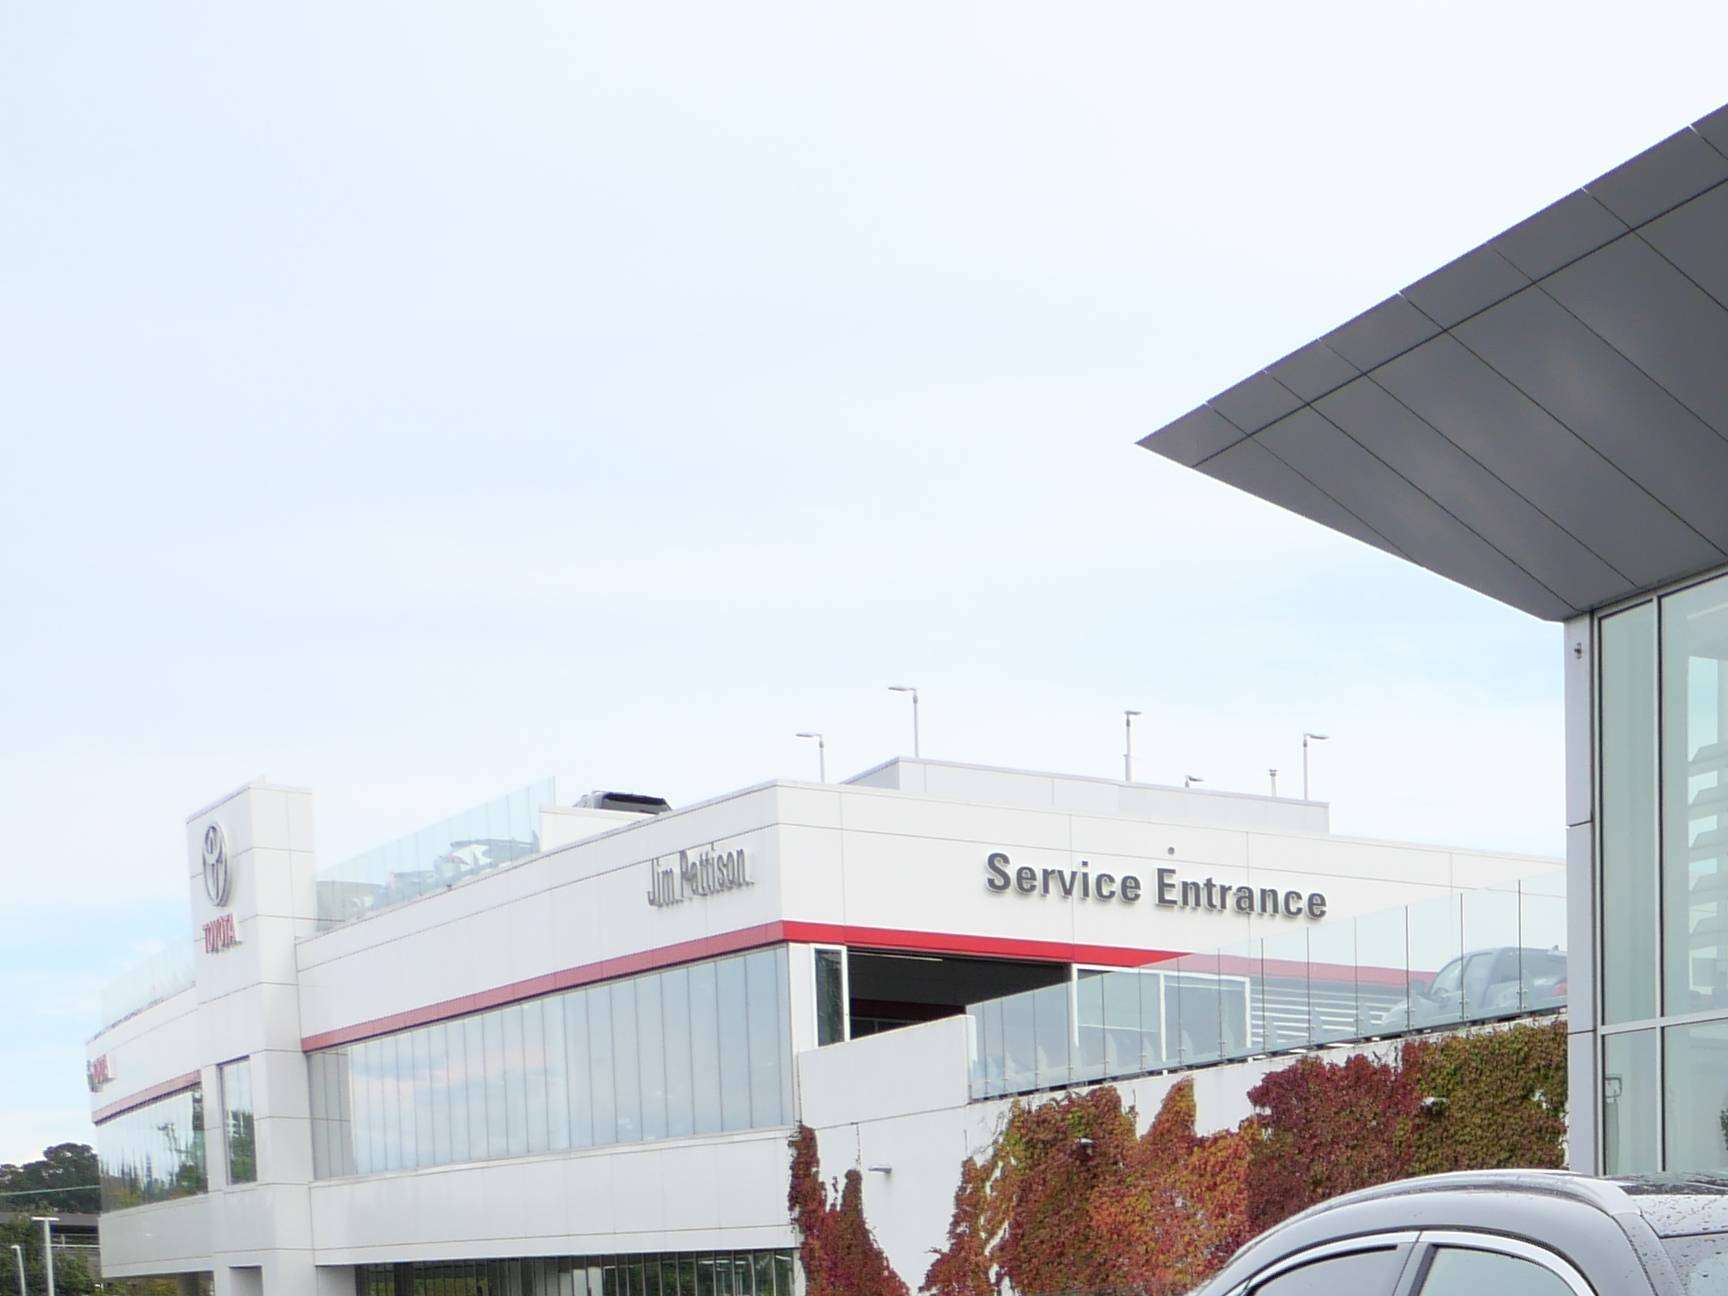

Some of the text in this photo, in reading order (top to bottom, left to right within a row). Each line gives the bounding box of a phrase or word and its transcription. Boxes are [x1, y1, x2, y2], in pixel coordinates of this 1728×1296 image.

[647, 840, 752, 908] Jim Pattison
[985, 851, 1329, 921] Service Entrance
[201, 913, 238, 954] TOYOTA
